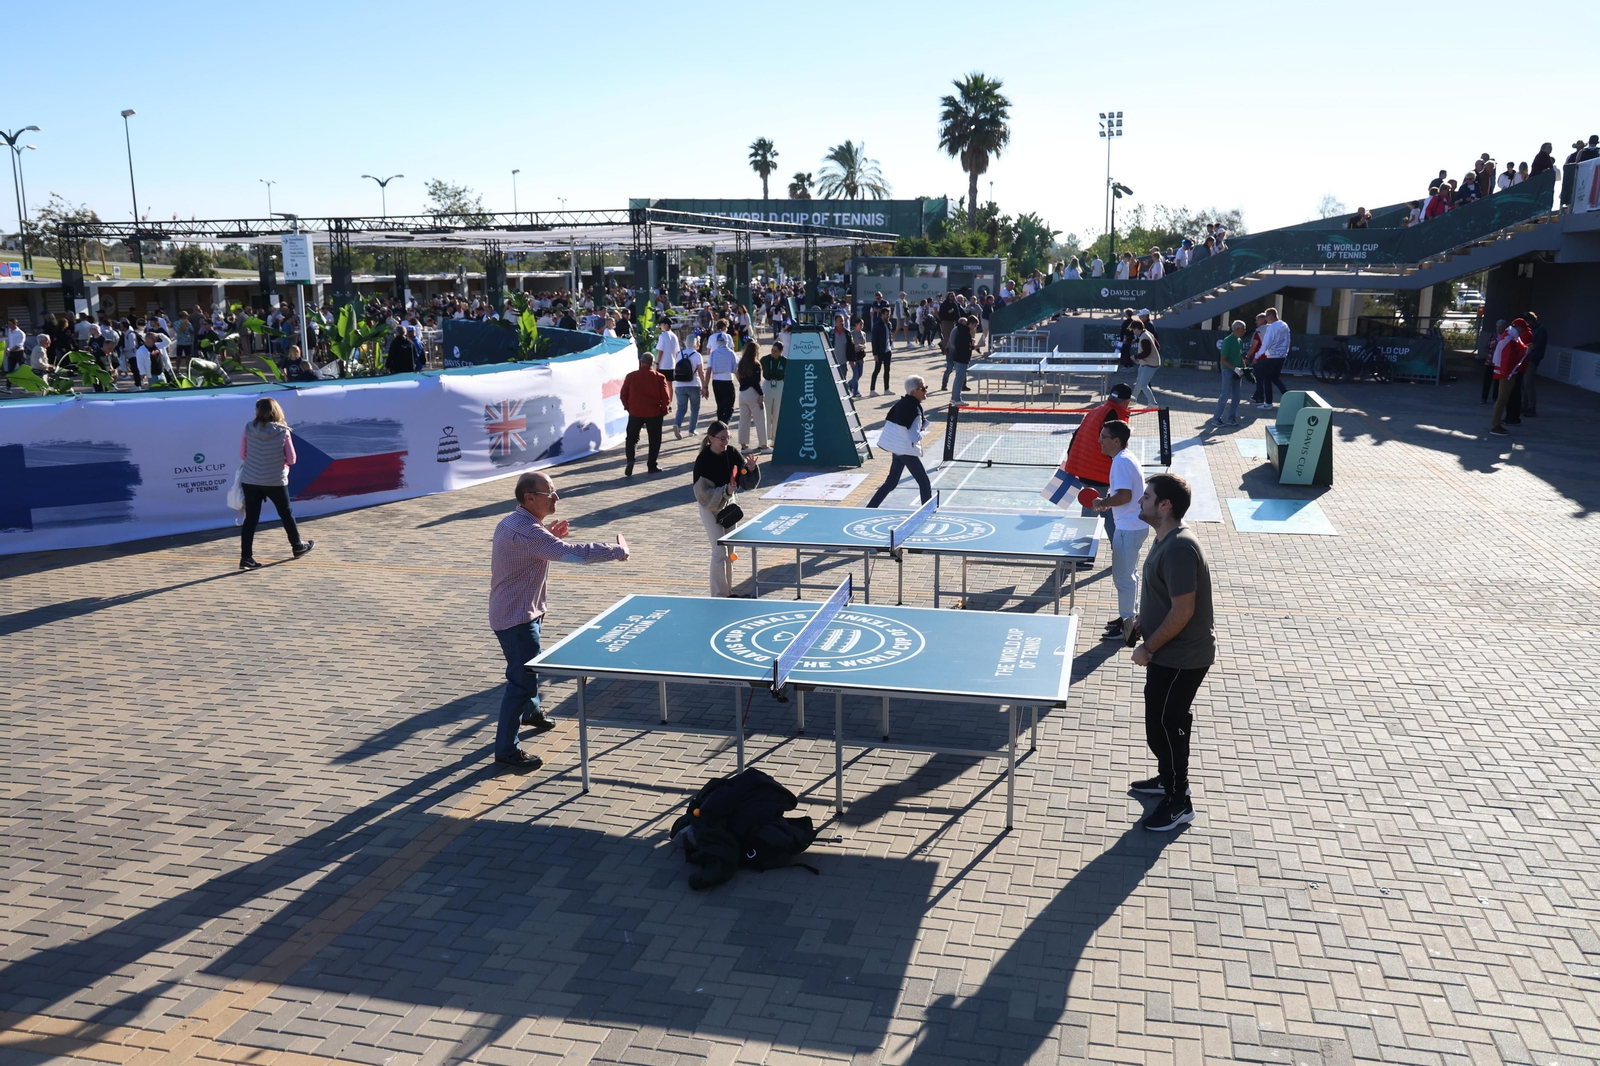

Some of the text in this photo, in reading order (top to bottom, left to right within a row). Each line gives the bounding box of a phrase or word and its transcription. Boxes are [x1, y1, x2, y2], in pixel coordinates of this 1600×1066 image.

[781, 212, 809, 225] CUP
[812, 212, 830, 226] OF
[832, 212, 885, 226] TENNIS
[444, 358, 460, 367] DAVIS
[1393, 347, 1410, 355] CUP
[799, 363, 818, 408] Camps
[801, 409, 816, 421] &
[799, 422, 817, 460] Juvé
[1296, 428, 1314, 477] DAVIS CUP
[174, 463, 226, 474] DAVIS CUP
[196, 485, 219, 493] TENNIS
[596, 614, 644, 643] OF TENNIS
[605, 609, 671, 653] THE WORLD CUP
[724, 613, 807, 662] DAVIS CUP FINALS
[794, 613, 912, 668] THE WORLD CUP OF TENNIS
[994, 628, 1025, 677] THE WORLD CUP
[1018, 637, 1042, 669] OF TENNIS
